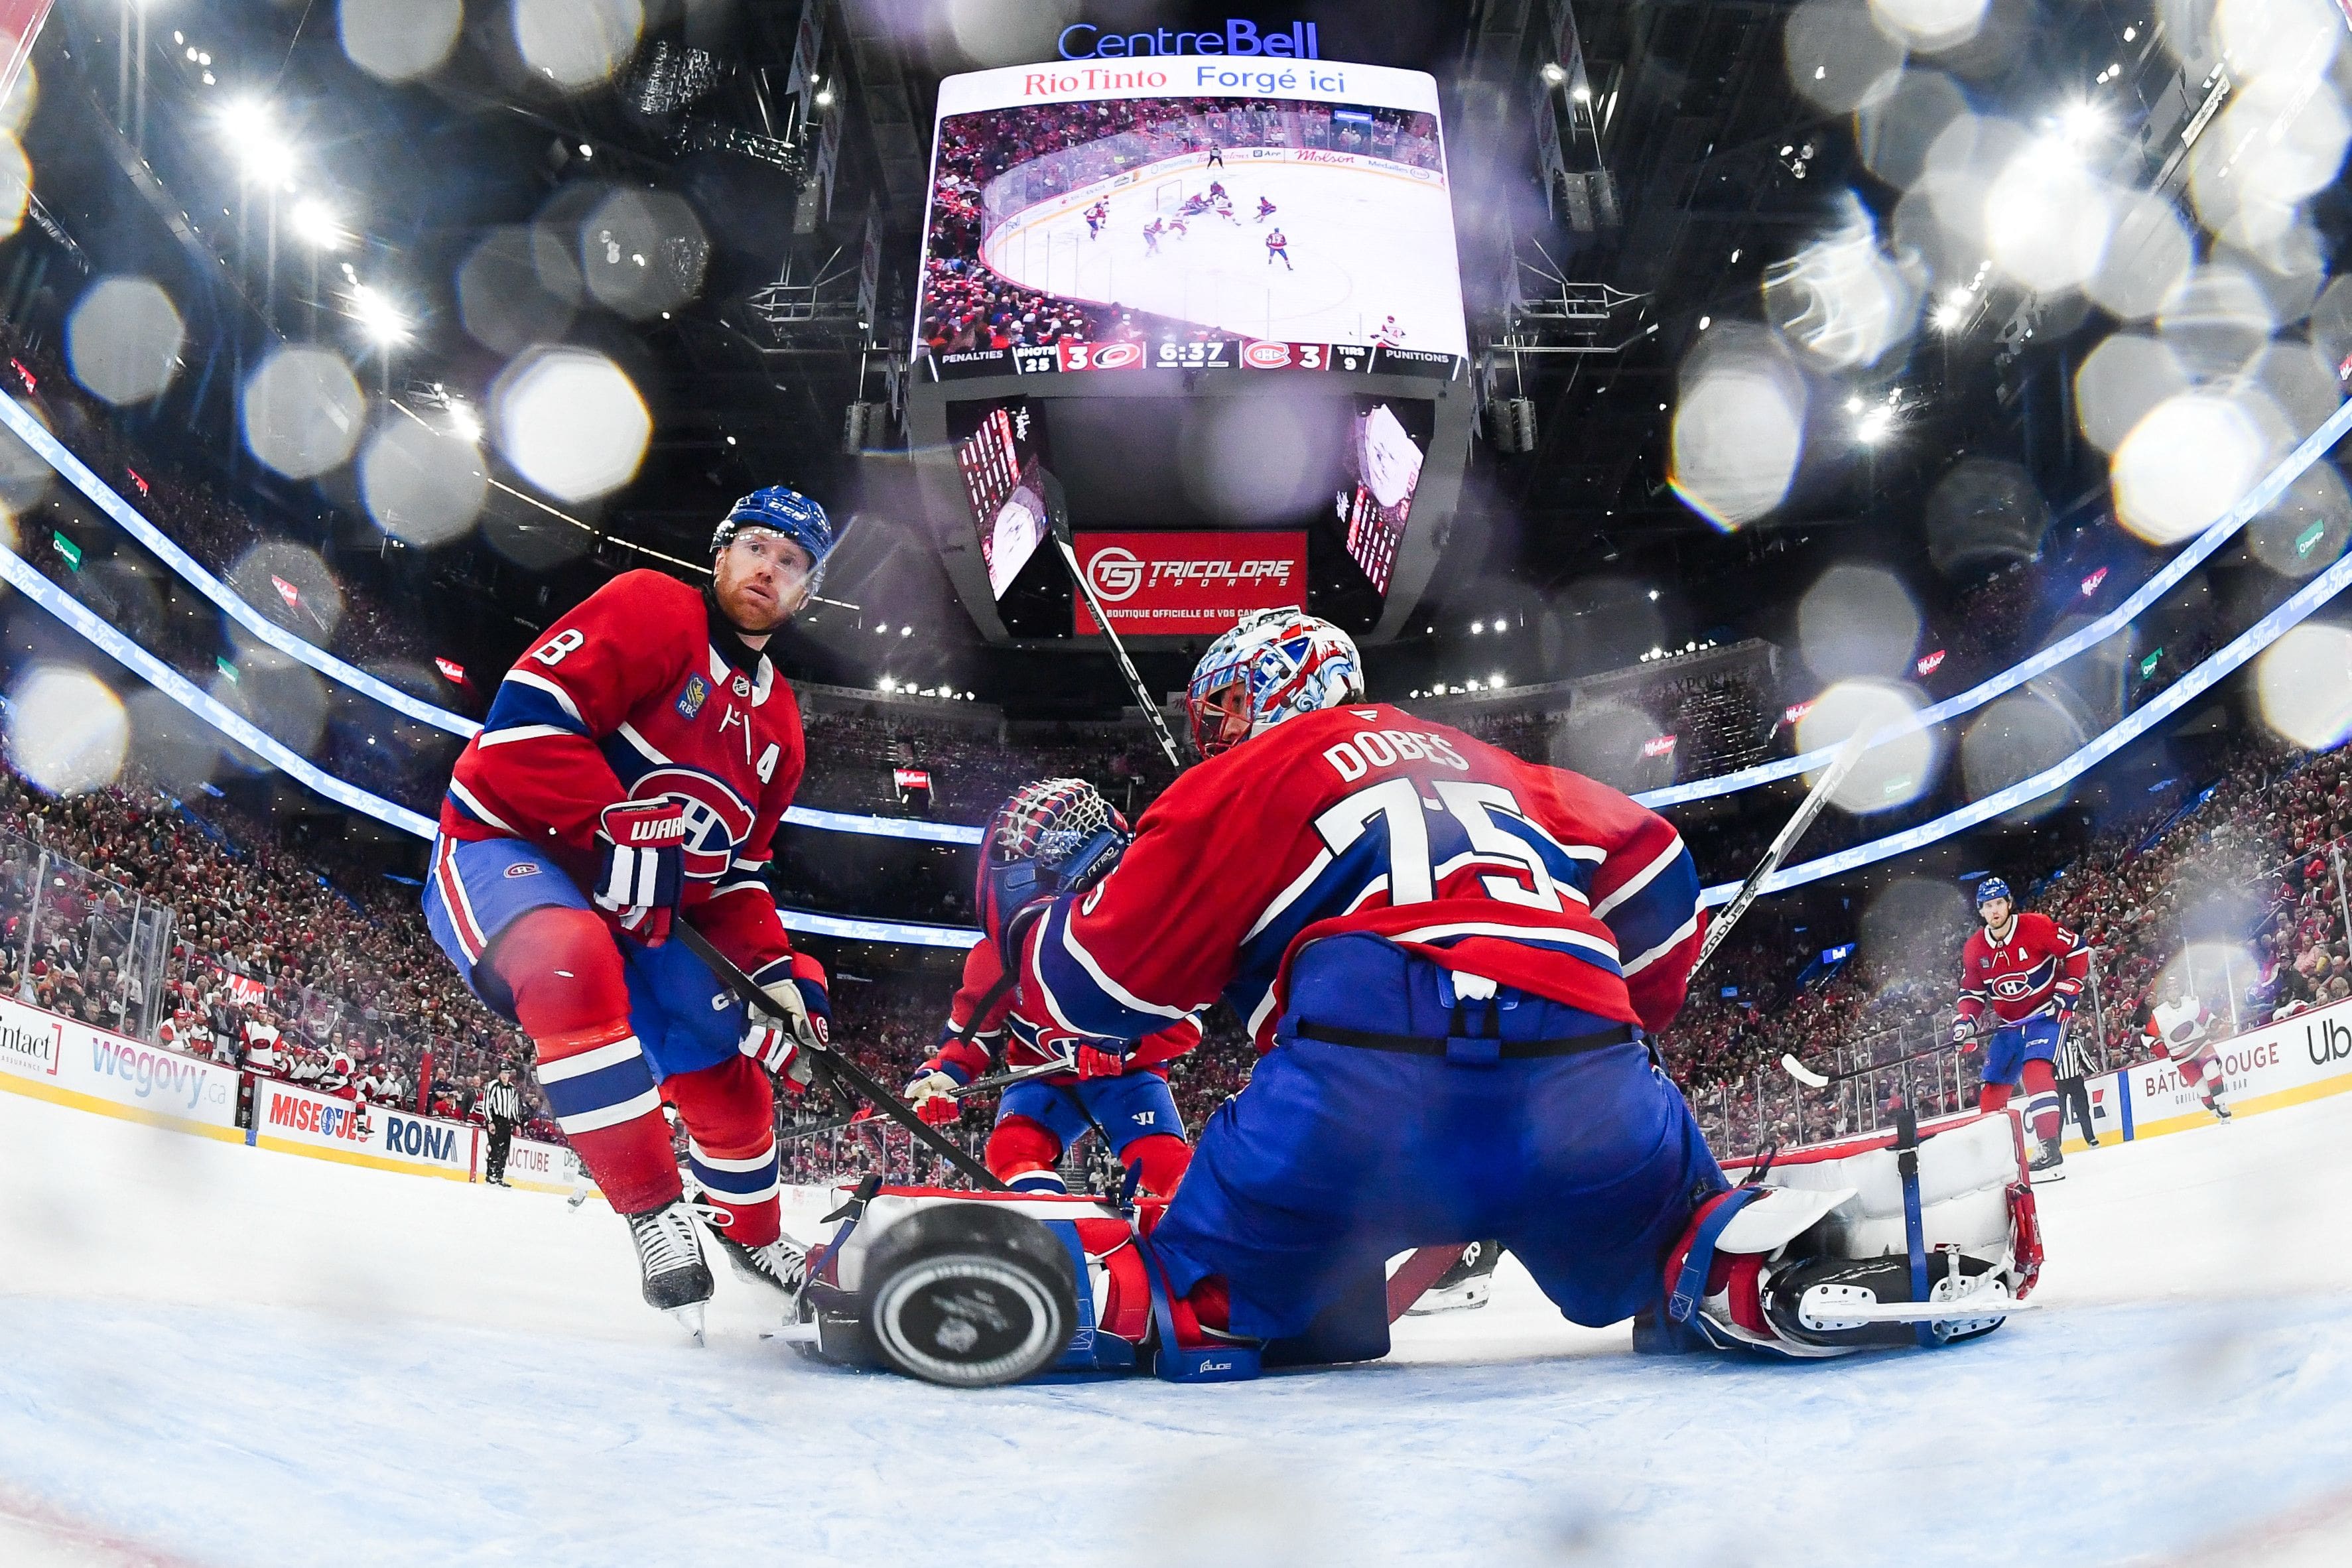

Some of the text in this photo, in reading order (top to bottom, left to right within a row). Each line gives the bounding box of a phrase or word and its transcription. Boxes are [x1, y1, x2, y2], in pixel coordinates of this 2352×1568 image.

[1197, 66, 1297, 94] Forgé
[1311, 70, 1344, 94] ici
[1295, 147, 1354, 164] Molson
[942, 350, 1004, 364] PENALTIES
[1017, 346, 1056, 358] SHOTS
[1067, 346, 1088, 370] 3
[1159, 342, 1224, 361] 6:37
[1298, 345, 1322, 369] 3
[1337, 345, 1366, 357] TIRS
[1386, 348, 1450, 364] PUNITIONS
[1025, 358, 1051, 373] 25
[1343, 357, 1357, 371] 9
[1150, 560, 1295, 578] TRICOLORE
[1148, 578, 1288, 588] SPORTS
[1106, 608, 1256, 619] BOUTIQUE OFFICIELLE DE VOS CAN
[531, 628, 584, 666] 8
[678, 700, 696, 718] RBC
[756, 743, 780, 785] A
[1313, 777, 1565, 914] 75
[1087, 846, 1115, 878] NITRO
[2056, 927, 2073, 946] 17
[2018, 947, 2029, 962] A
[2146, 1042, 2280, 1097] BÂTO OUGE
[386, 1116, 458, 1162] RONA
[507, 1148, 550, 1173] UCTUBE
